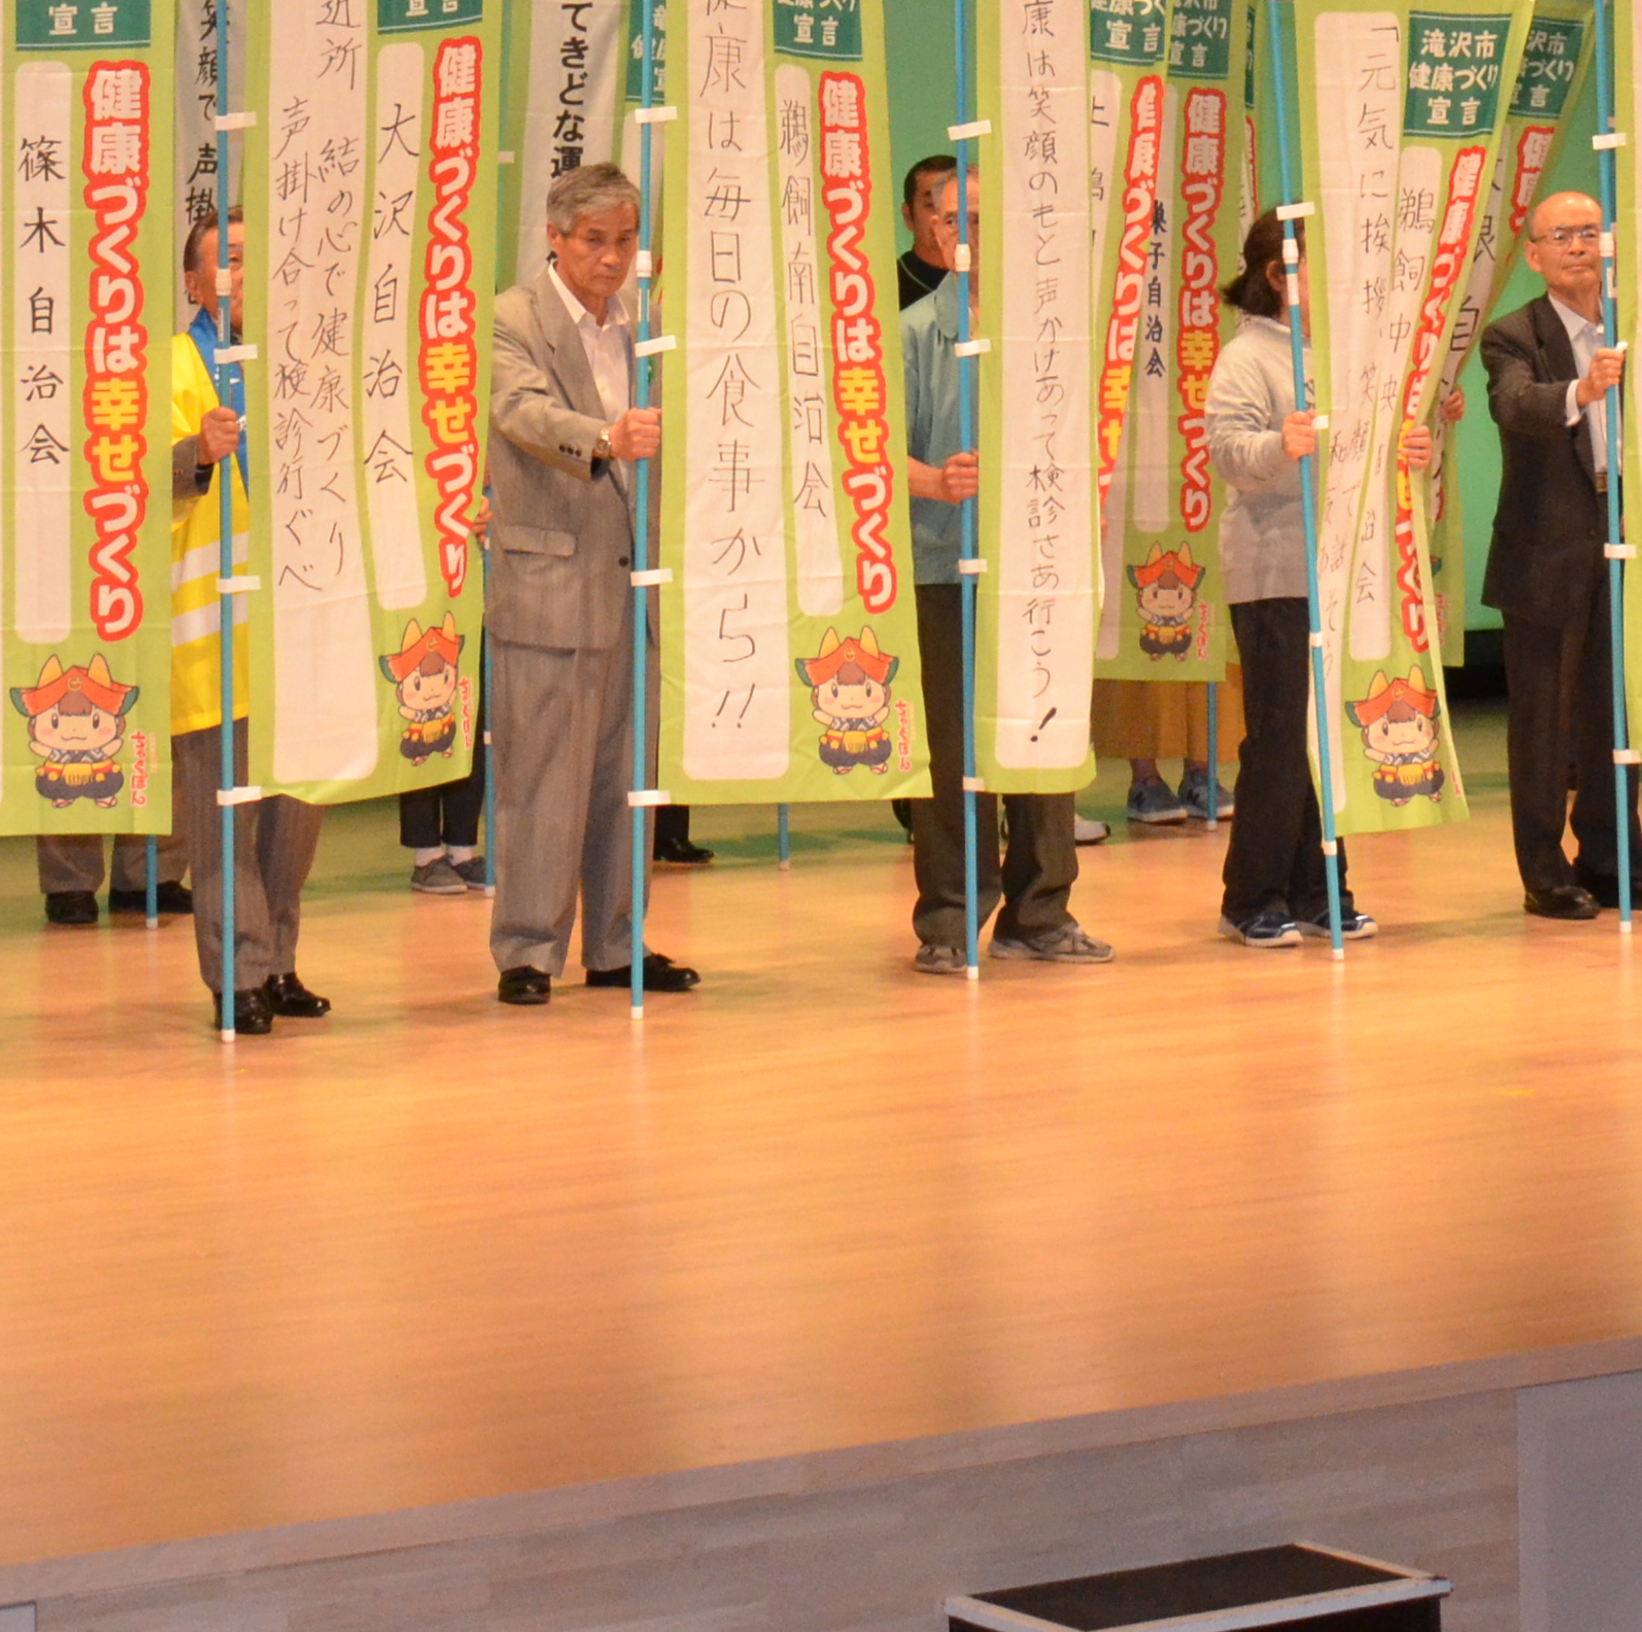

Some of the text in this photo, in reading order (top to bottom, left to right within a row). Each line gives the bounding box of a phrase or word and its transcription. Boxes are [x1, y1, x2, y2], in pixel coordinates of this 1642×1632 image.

[49, 3, 118, 36] 宣言
[793, 14, 839, 46] 宣言
[1421, 29, 1497, 58] 滝沢市
[18, 136, 69, 465] 篠木自治会
[90, 68, 142, 633] 健康づくりは幸せづくり
[364, 103, 420, 485] 大沢自治会
[424, 44, 477, 592] 健康づくりは幸せづくり
[823, 79, 894, 609] 健康づくりは幸せづくり
